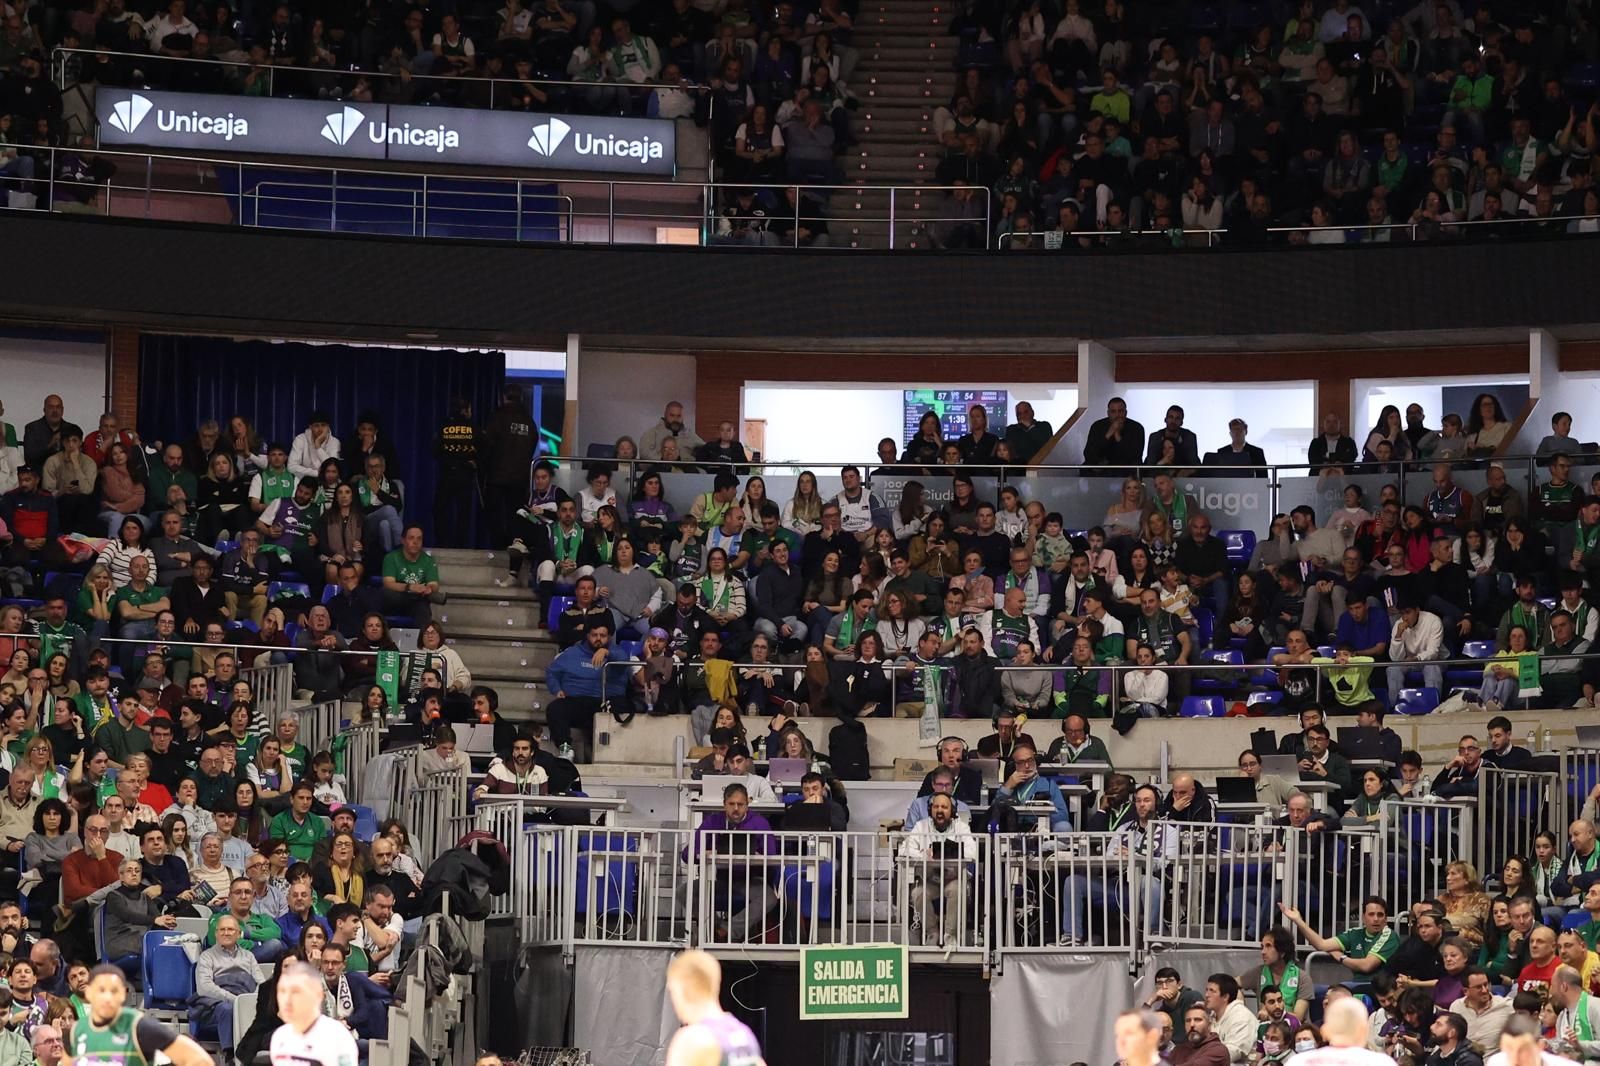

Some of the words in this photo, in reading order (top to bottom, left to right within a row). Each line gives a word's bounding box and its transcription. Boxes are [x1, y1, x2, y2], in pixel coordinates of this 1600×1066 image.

[157, 109, 249, 141] Unicaja
[369, 121, 460, 153] Unicaja
[574, 132, 664, 163] Unicaja
[937, 392, 947, 401] 57
[950, 391, 960, 400] VS
[964, 392, 974, 401] 54
[442, 425, 473, 434] COFER
[948, 415, 966, 424] 1:39
[813, 959, 865, 981] SALIDA
[876, 959, 894, 979] DE
[808, 984, 899, 1005] EMERGENCIA
